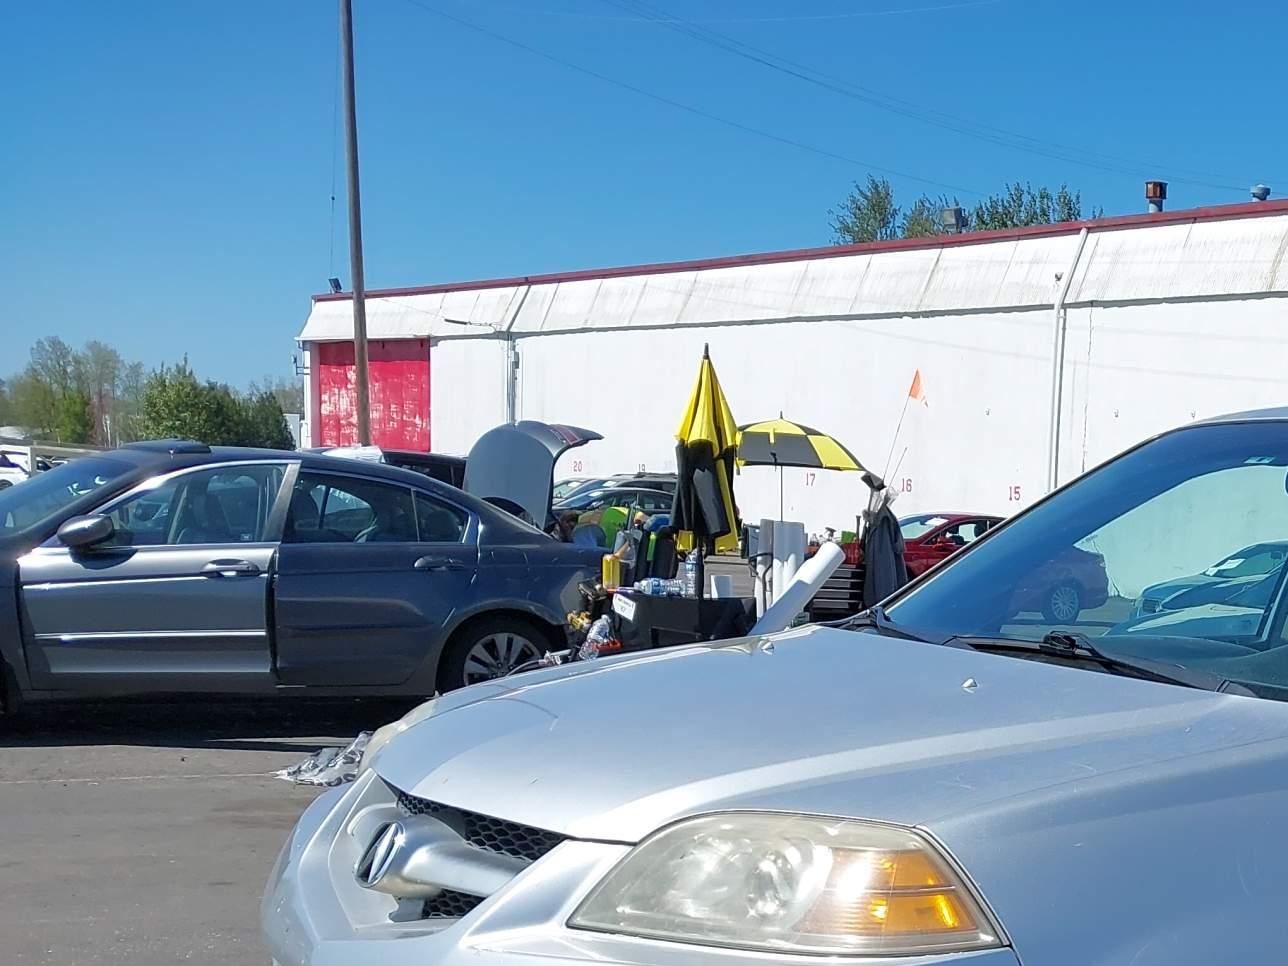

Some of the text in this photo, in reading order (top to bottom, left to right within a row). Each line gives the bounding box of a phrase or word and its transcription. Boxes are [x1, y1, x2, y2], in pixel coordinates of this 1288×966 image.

[573, 461, 583, 472] 20
[805, 473, 816, 487] 17
[901, 478, 913, 493] 16
[1008, 486, 1021, 501] 15
